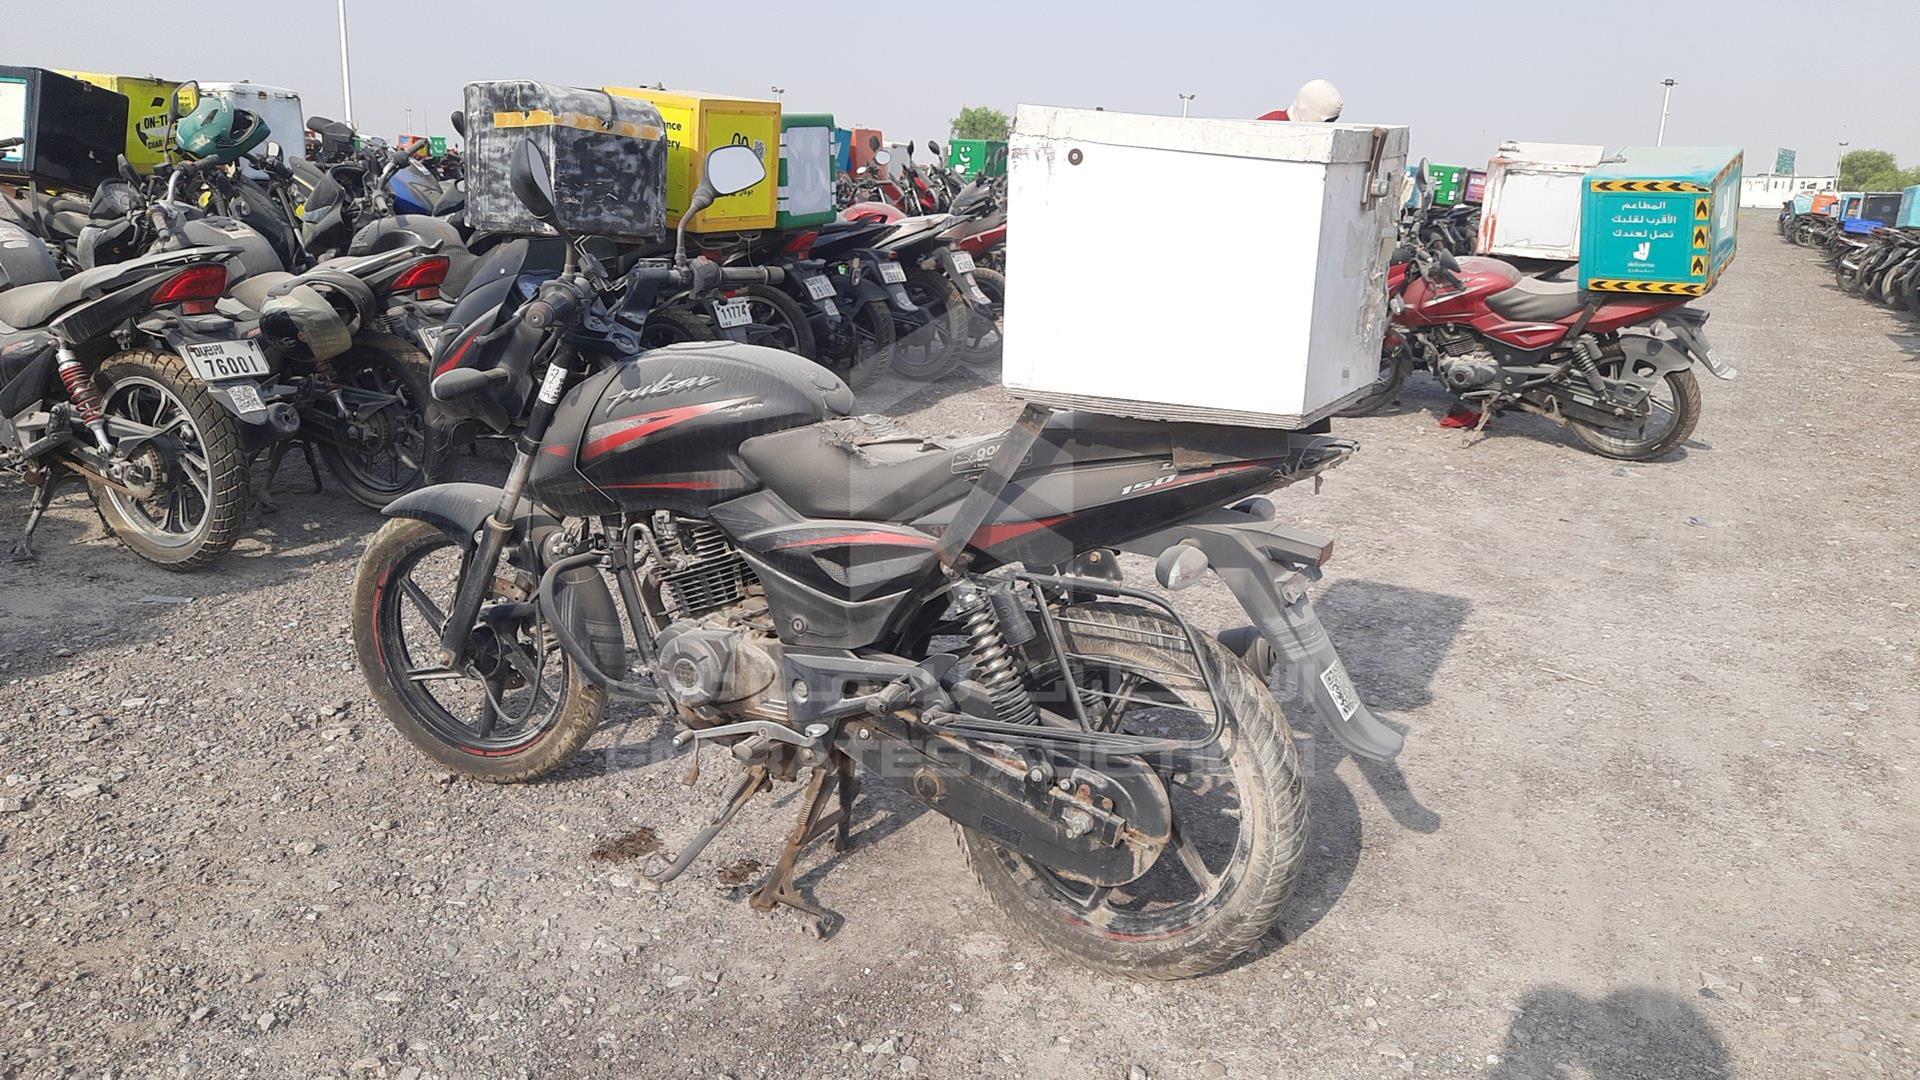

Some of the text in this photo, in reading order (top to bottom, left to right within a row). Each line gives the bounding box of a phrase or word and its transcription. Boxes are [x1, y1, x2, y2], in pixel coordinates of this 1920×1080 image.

[1621, 201, 1666, 211] المطاعم
[204, 355, 258, 377] 76001
[1121, 474, 1176, 496] 150
